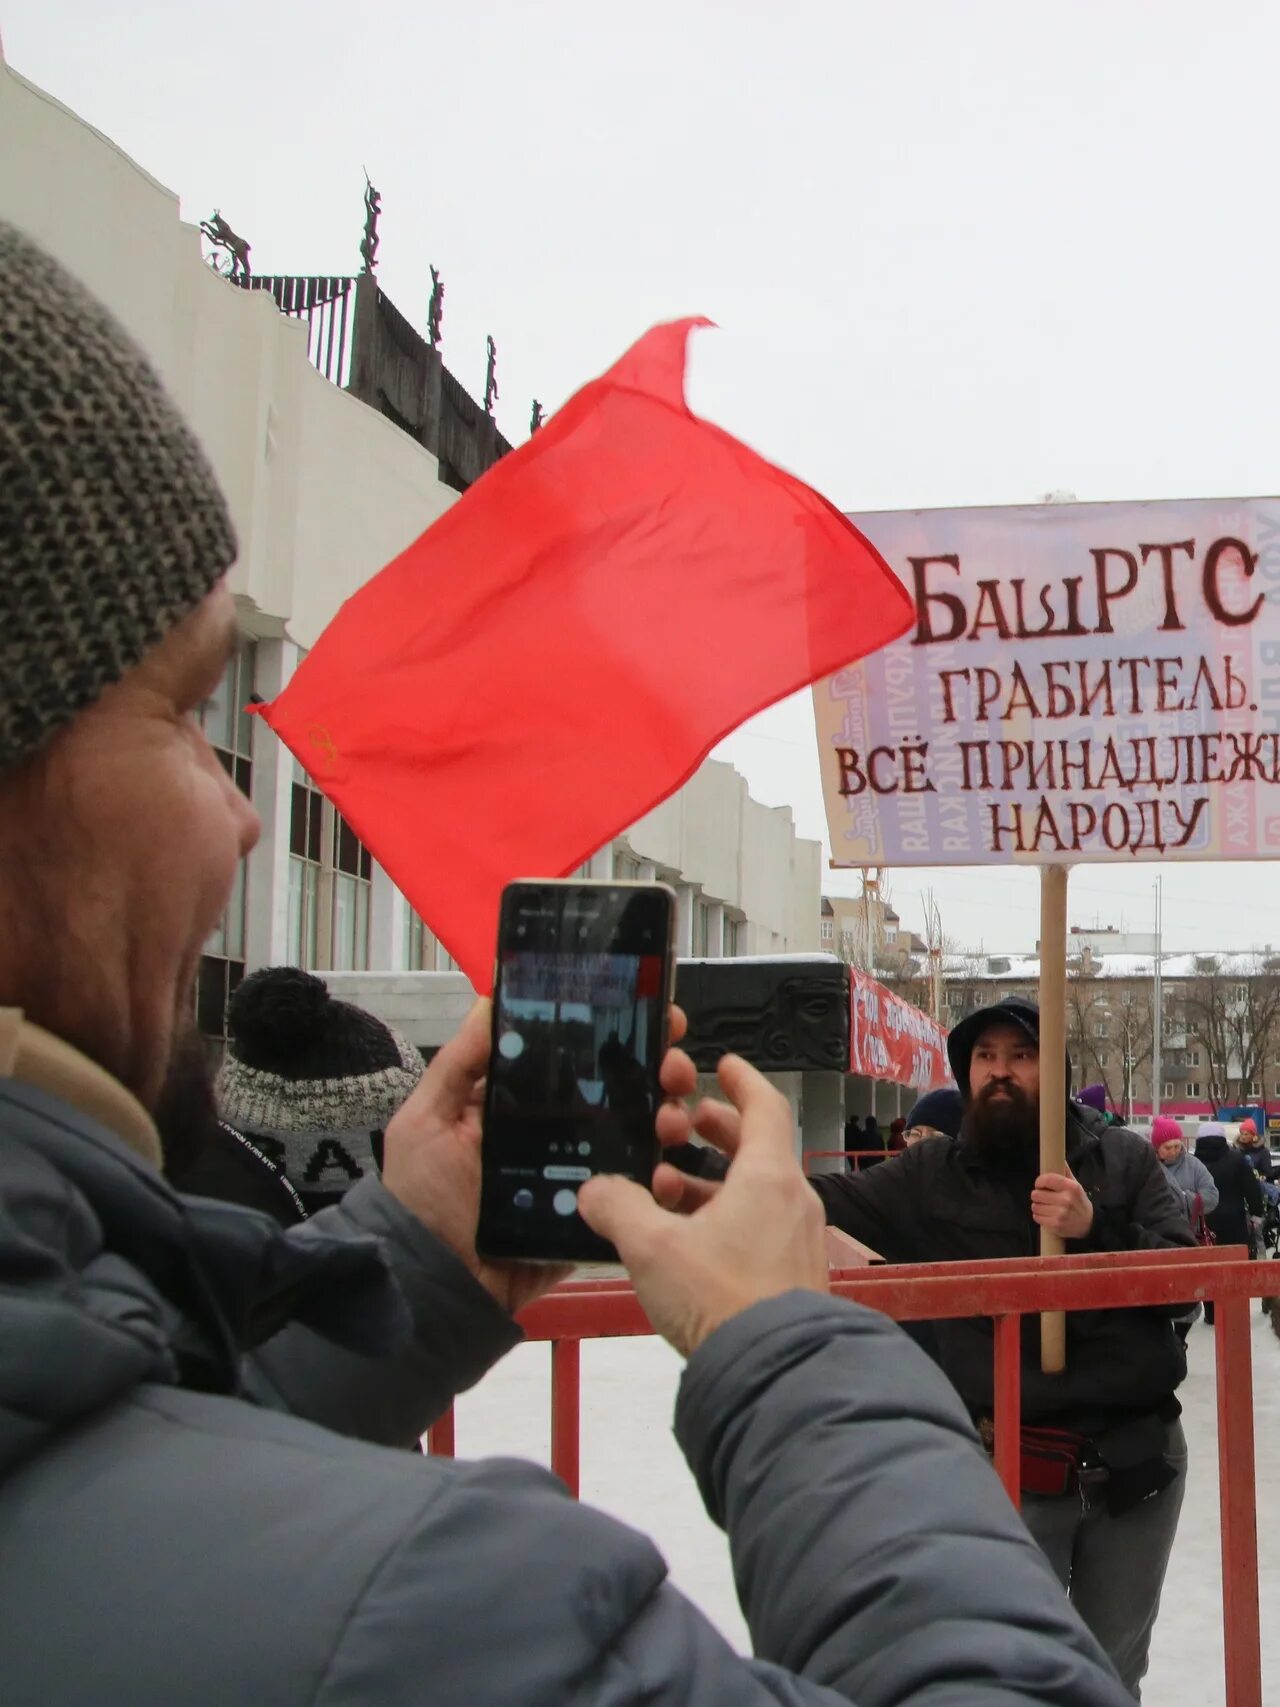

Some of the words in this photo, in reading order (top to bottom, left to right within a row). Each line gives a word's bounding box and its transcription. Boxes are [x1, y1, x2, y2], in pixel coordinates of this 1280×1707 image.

[938, 655, 1259, 724] ГРАБИТЕЛЬ.
[834, 734, 938, 799] ВСЁ
[986, 794, 1210, 857] НАРОДУ
